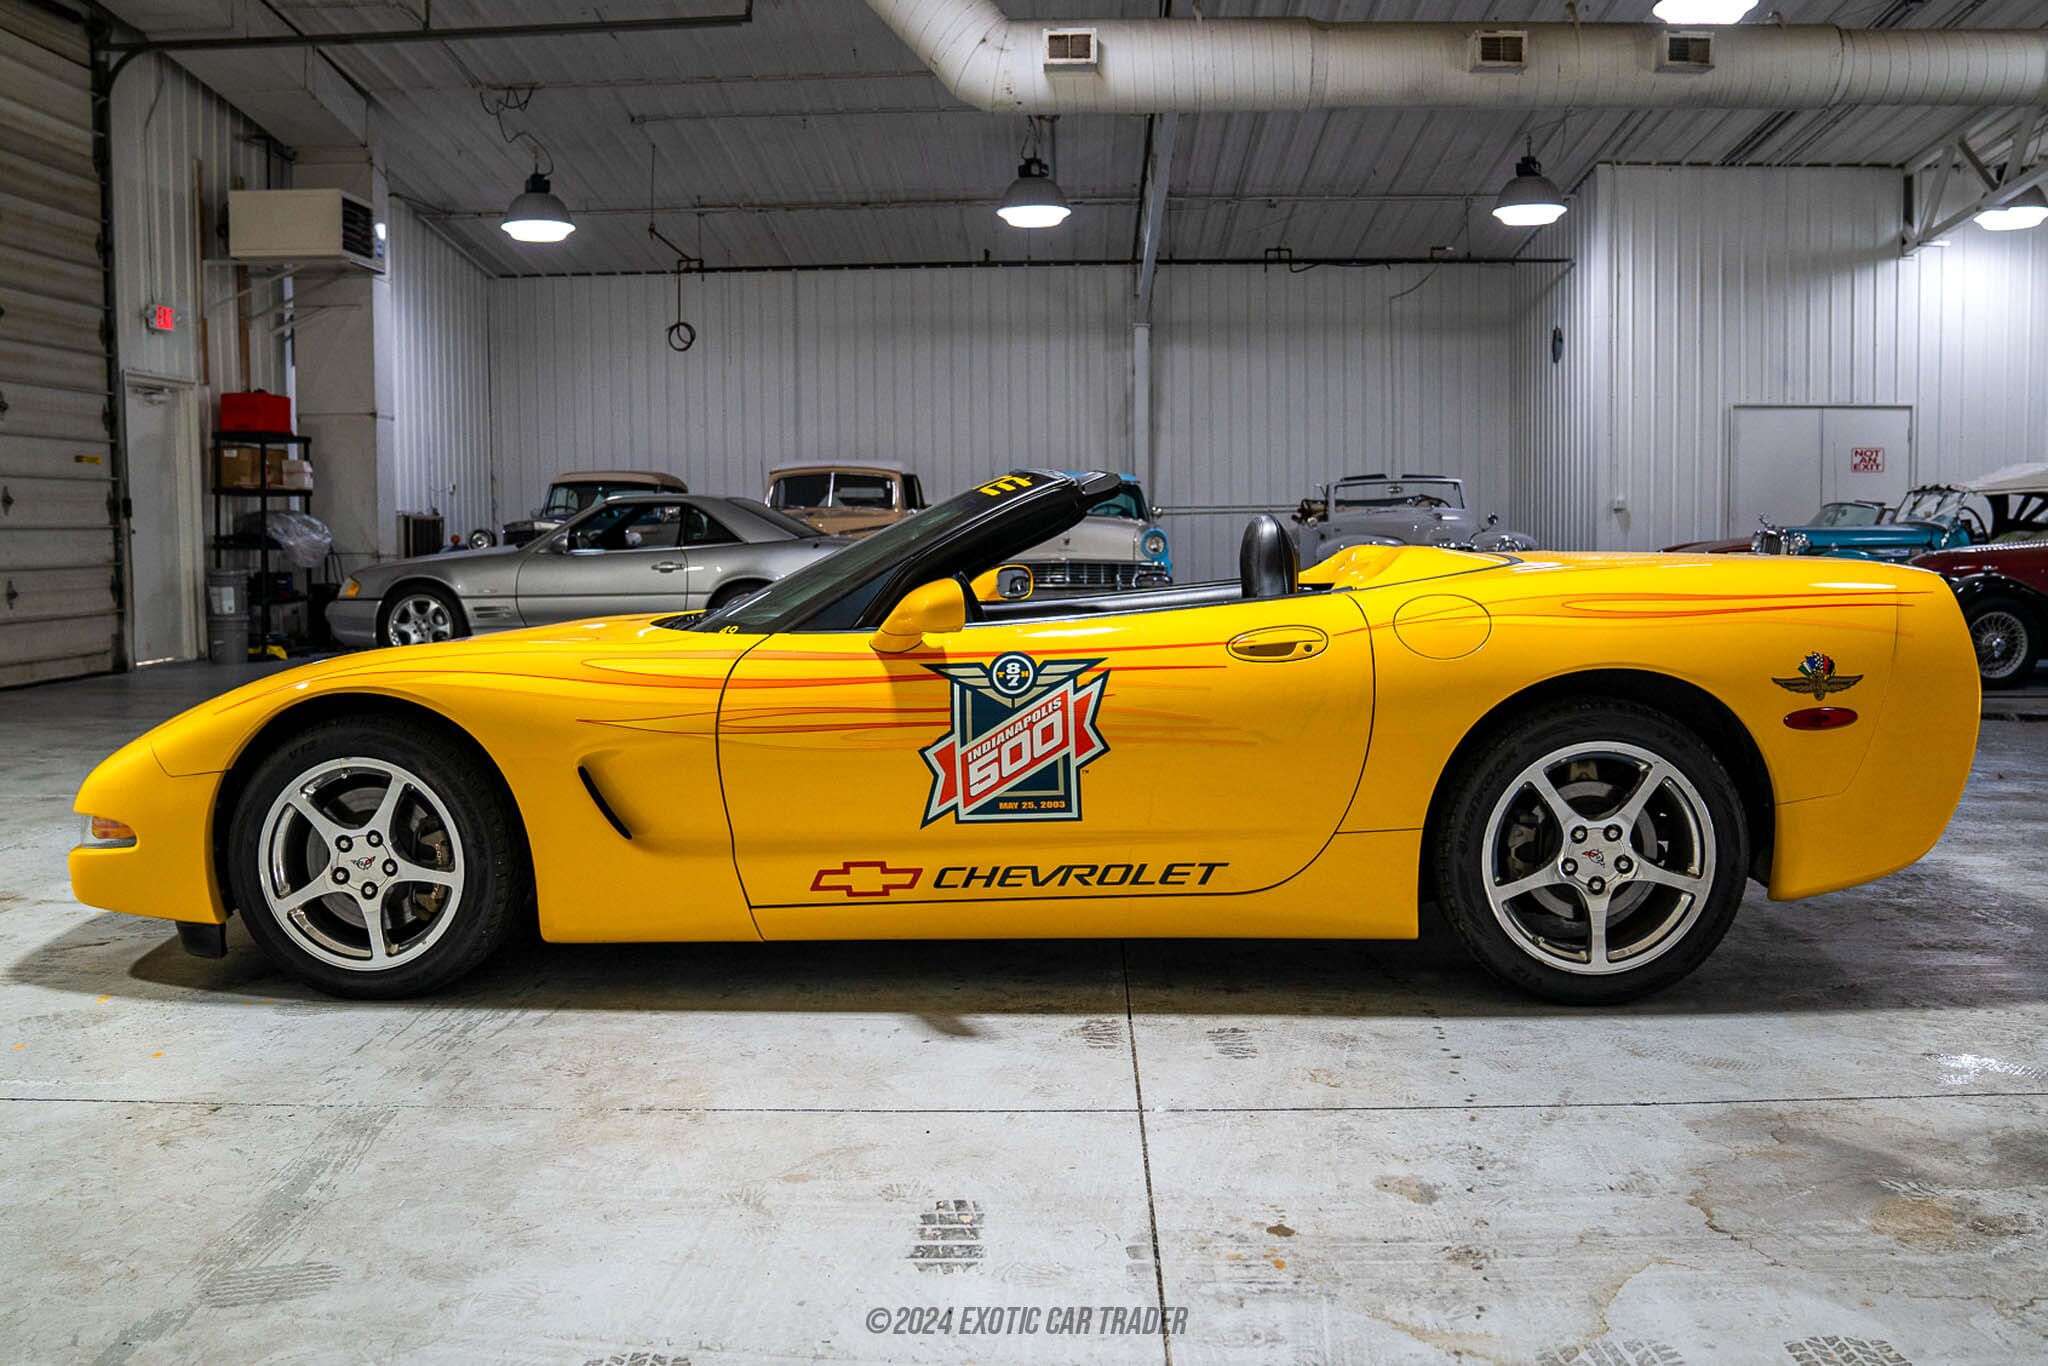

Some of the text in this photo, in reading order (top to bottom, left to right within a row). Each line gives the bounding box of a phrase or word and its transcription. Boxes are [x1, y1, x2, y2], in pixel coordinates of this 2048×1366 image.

[1854, 449, 1880, 457] NOT
[1853, 463, 1881, 471] EXIT
[967, 697, 1063, 762] INDIANAPOLIS
[969, 710, 1064, 797] 500
[1040, 801, 1066, 809] 2003
[933, 863, 1230, 889] CHEVROLET
